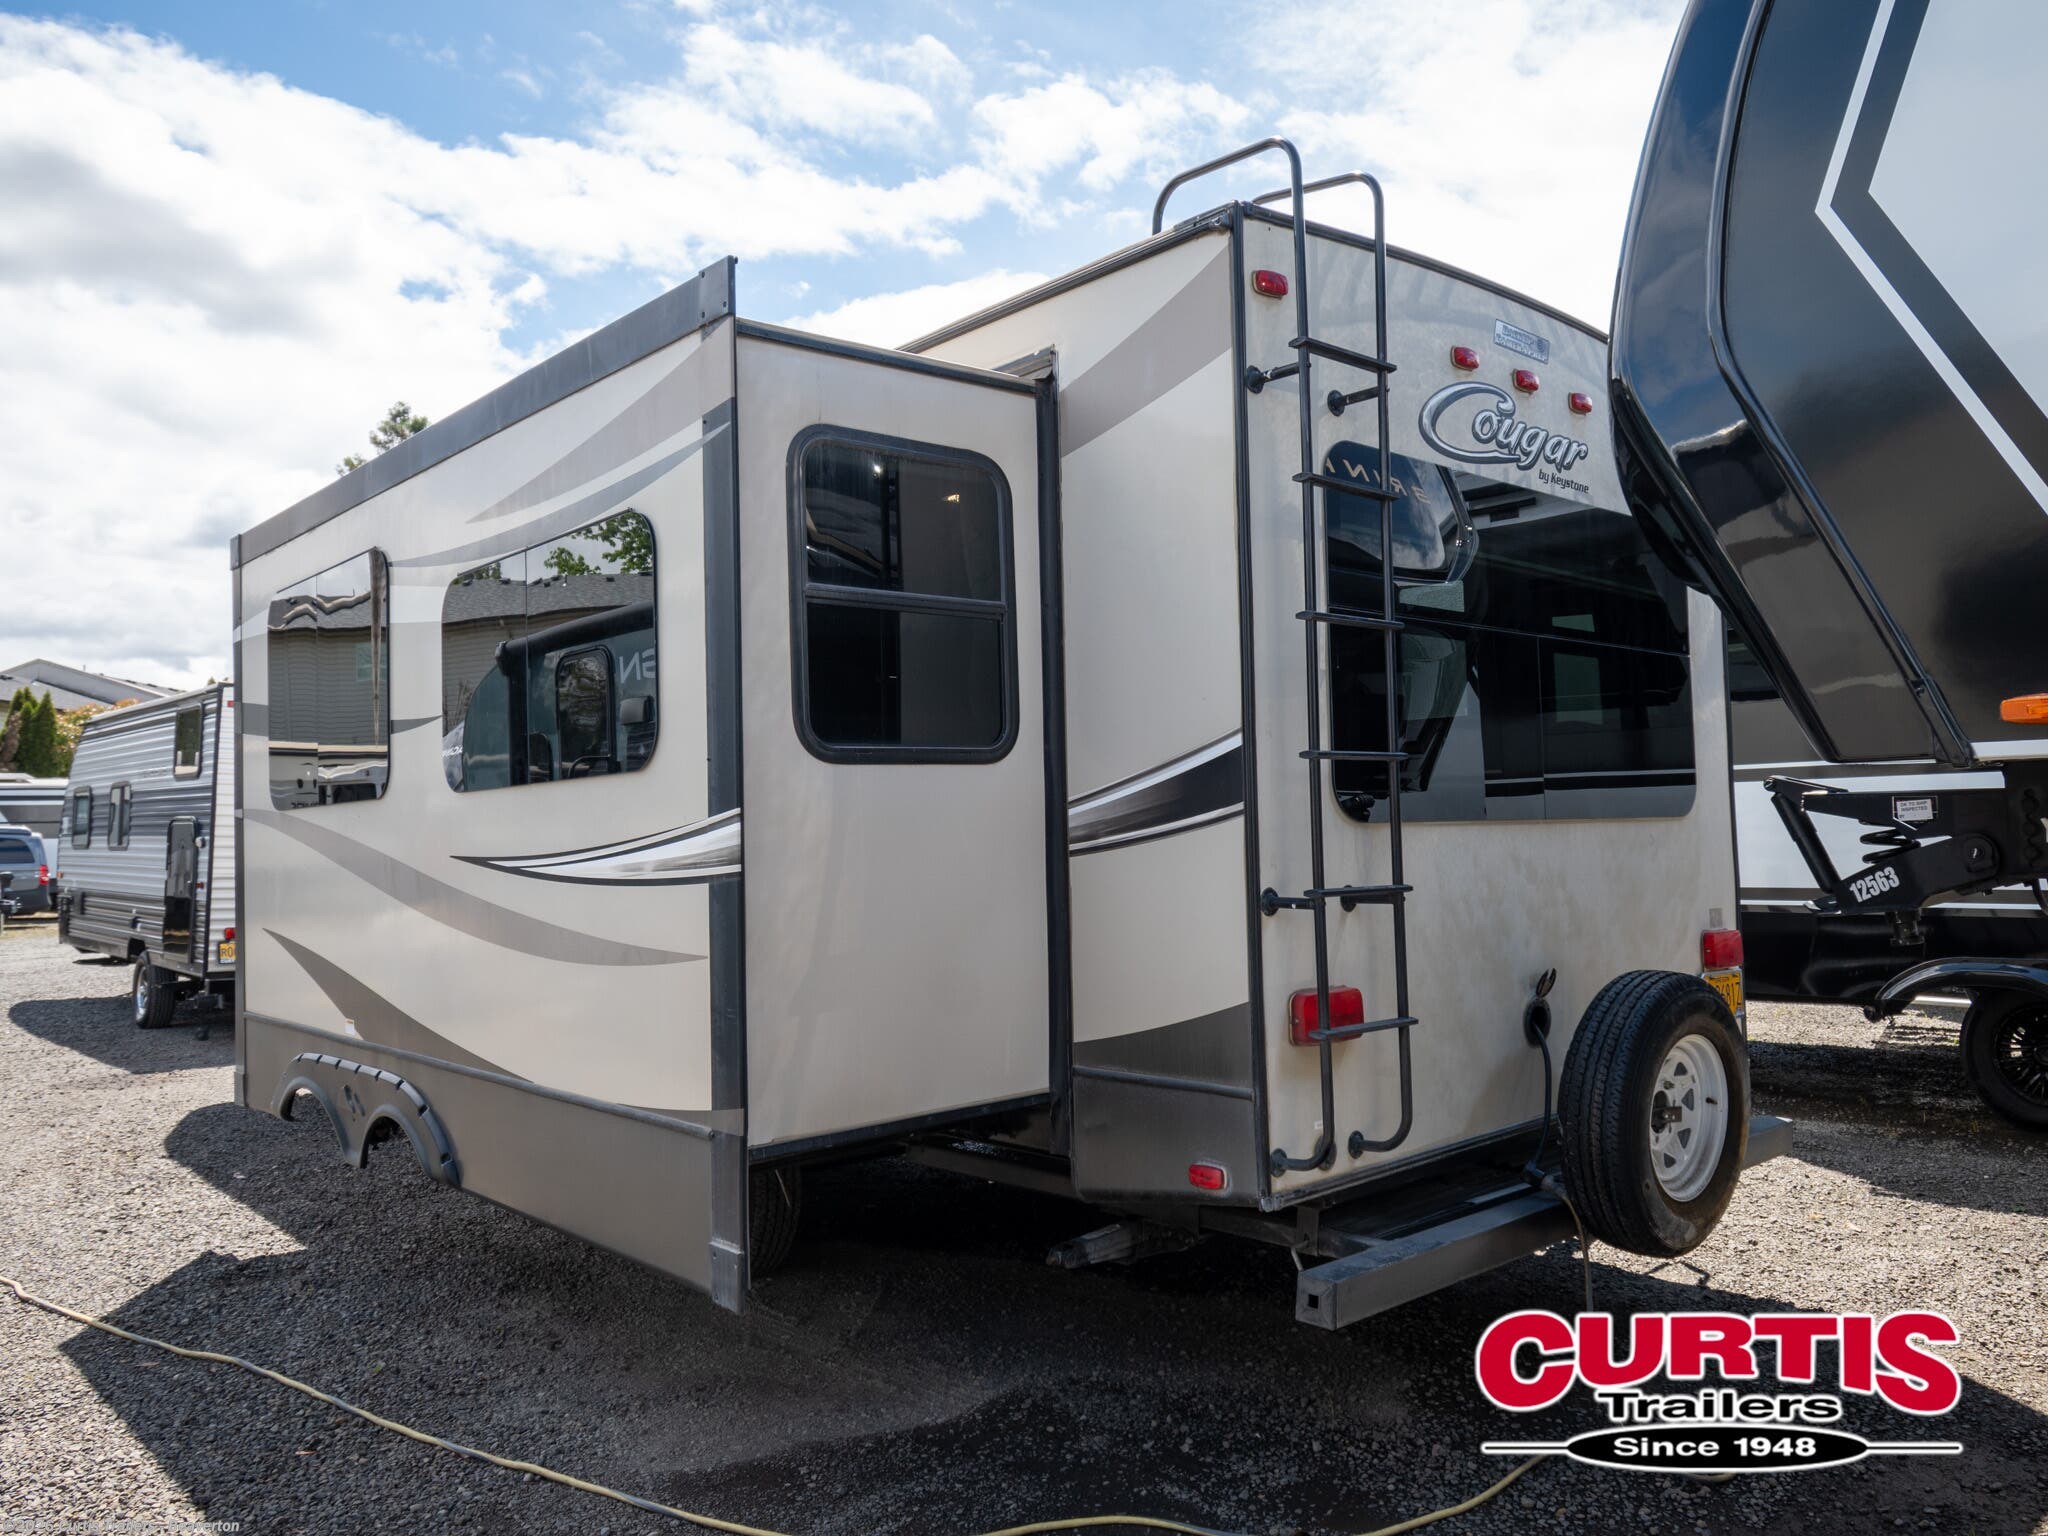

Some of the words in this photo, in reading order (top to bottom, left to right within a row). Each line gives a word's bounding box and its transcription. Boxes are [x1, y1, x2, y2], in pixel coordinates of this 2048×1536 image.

[1418, 381, 1588, 473] Cougar
[1538, 468, 1550, 484] by
[1551, 472, 1590, 494] Keystone
[1849, 866, 1900, 903] 12563
